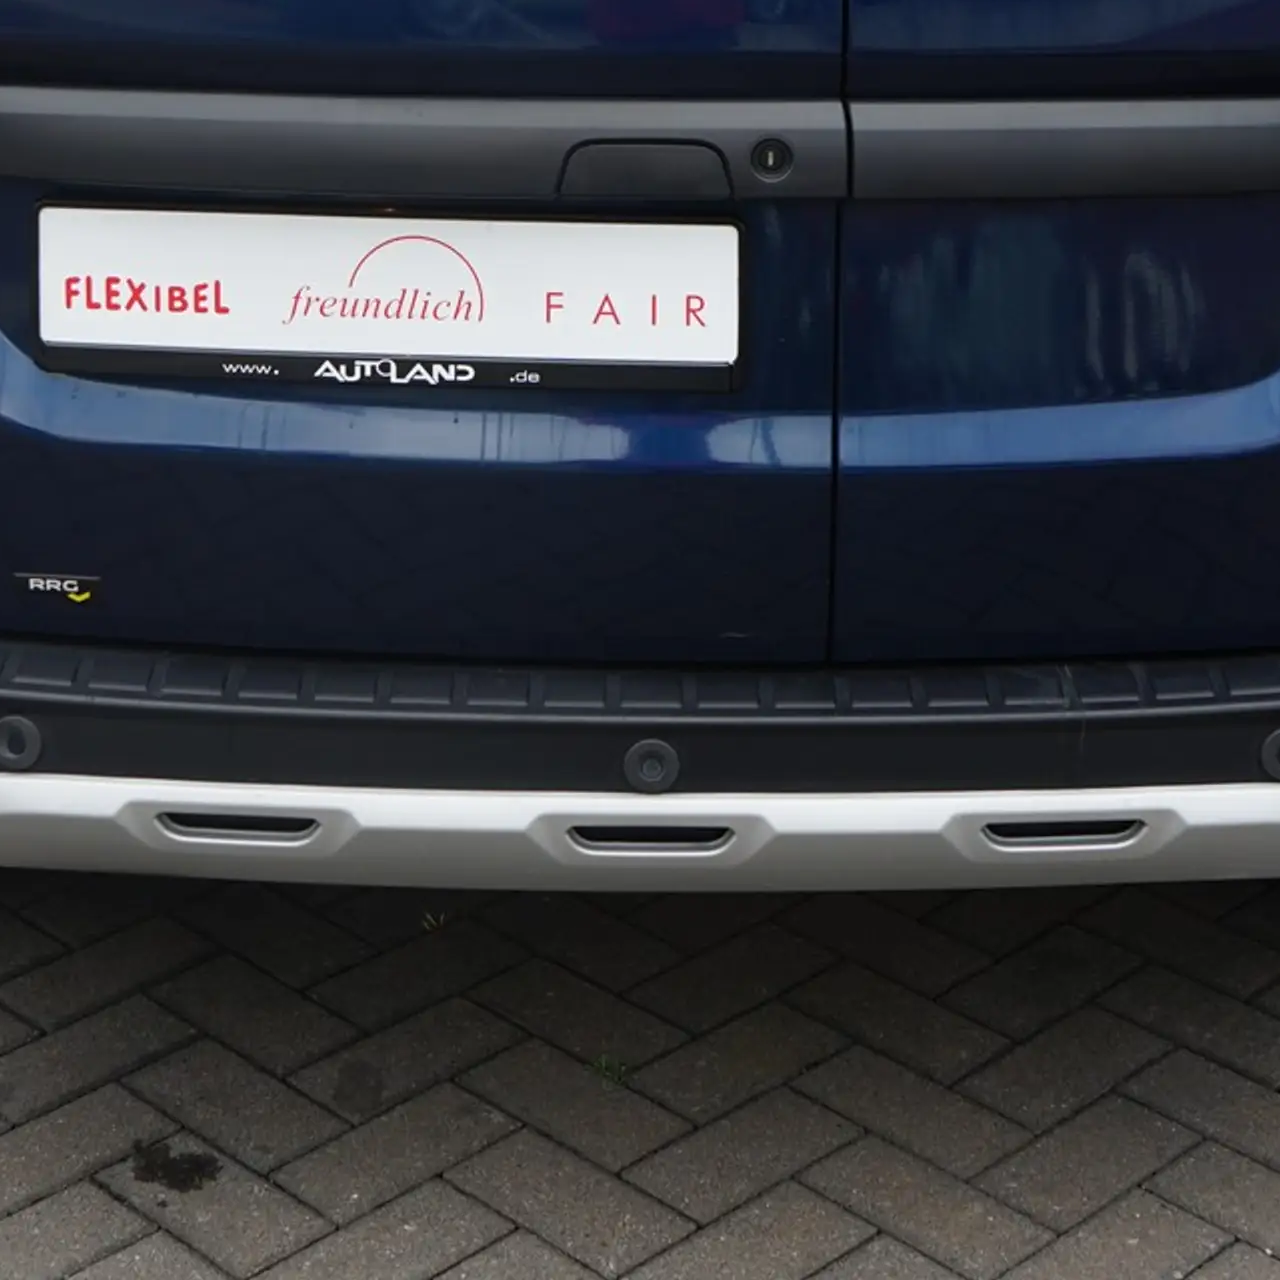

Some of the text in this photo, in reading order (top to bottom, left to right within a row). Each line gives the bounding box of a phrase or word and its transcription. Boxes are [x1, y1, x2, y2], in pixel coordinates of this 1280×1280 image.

[63, 275, 231, 316] FLEXIBEL
[281, 285, 474, 325] freundlich
[222, 358, 541, 386] www. AUTOLAND .de
[28, 577, 79, 592] RRG
